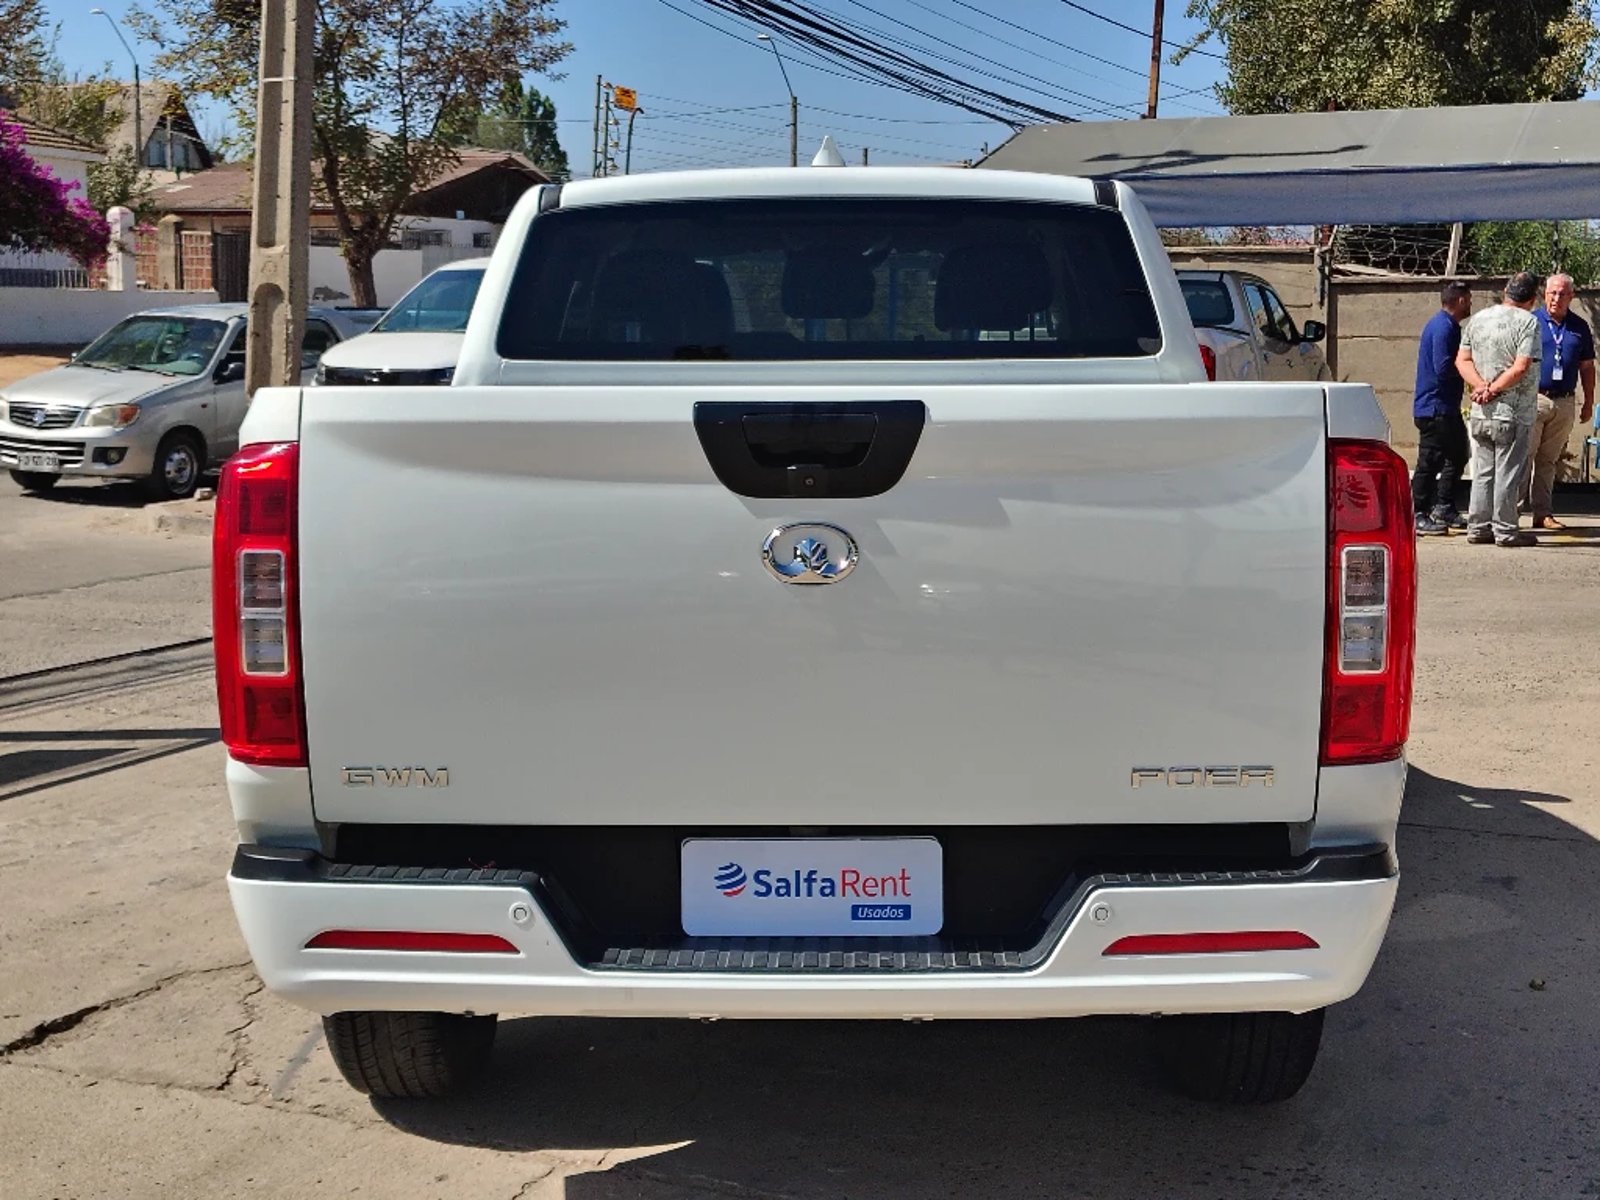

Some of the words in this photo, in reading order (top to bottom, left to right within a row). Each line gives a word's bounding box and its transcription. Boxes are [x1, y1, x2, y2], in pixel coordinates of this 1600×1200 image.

[341, 766, 449, 788] GWM
[1131, 765, 1274, 788] POER
[753, 868, 912, 898] SalfaRent
[858, 906, 904, 919] Usados
